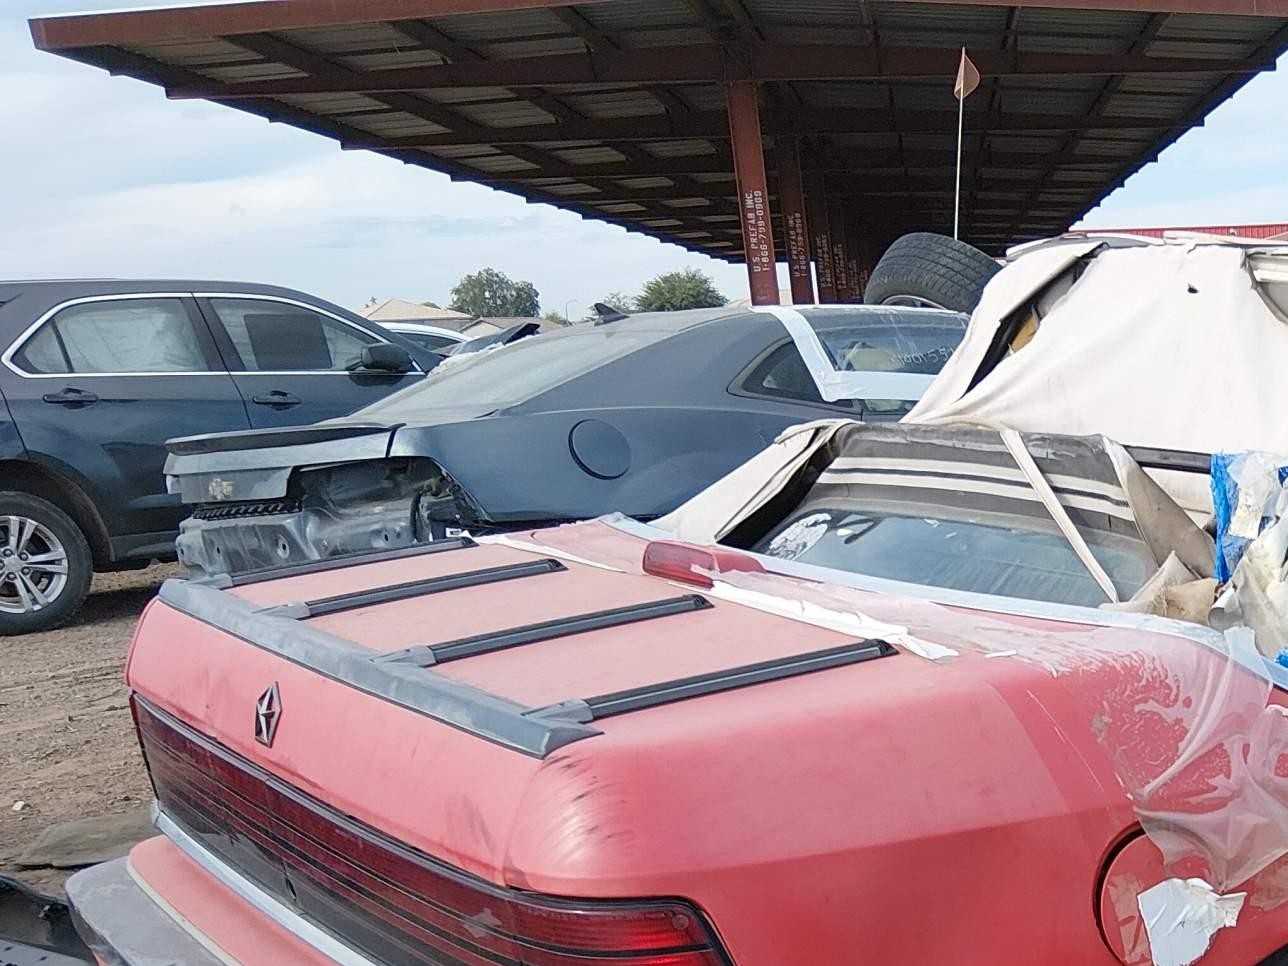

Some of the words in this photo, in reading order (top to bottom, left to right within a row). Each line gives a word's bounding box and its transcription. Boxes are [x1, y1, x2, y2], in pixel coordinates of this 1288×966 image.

[745, 190, 755, 209] INC.
[746, 213, 759, 249] PREFAB
[753, 190, 770, 272] 1-866-799-0909
[790, 230, 799, 259] PREFAB
[752, 254, 761, 273] U.S.
